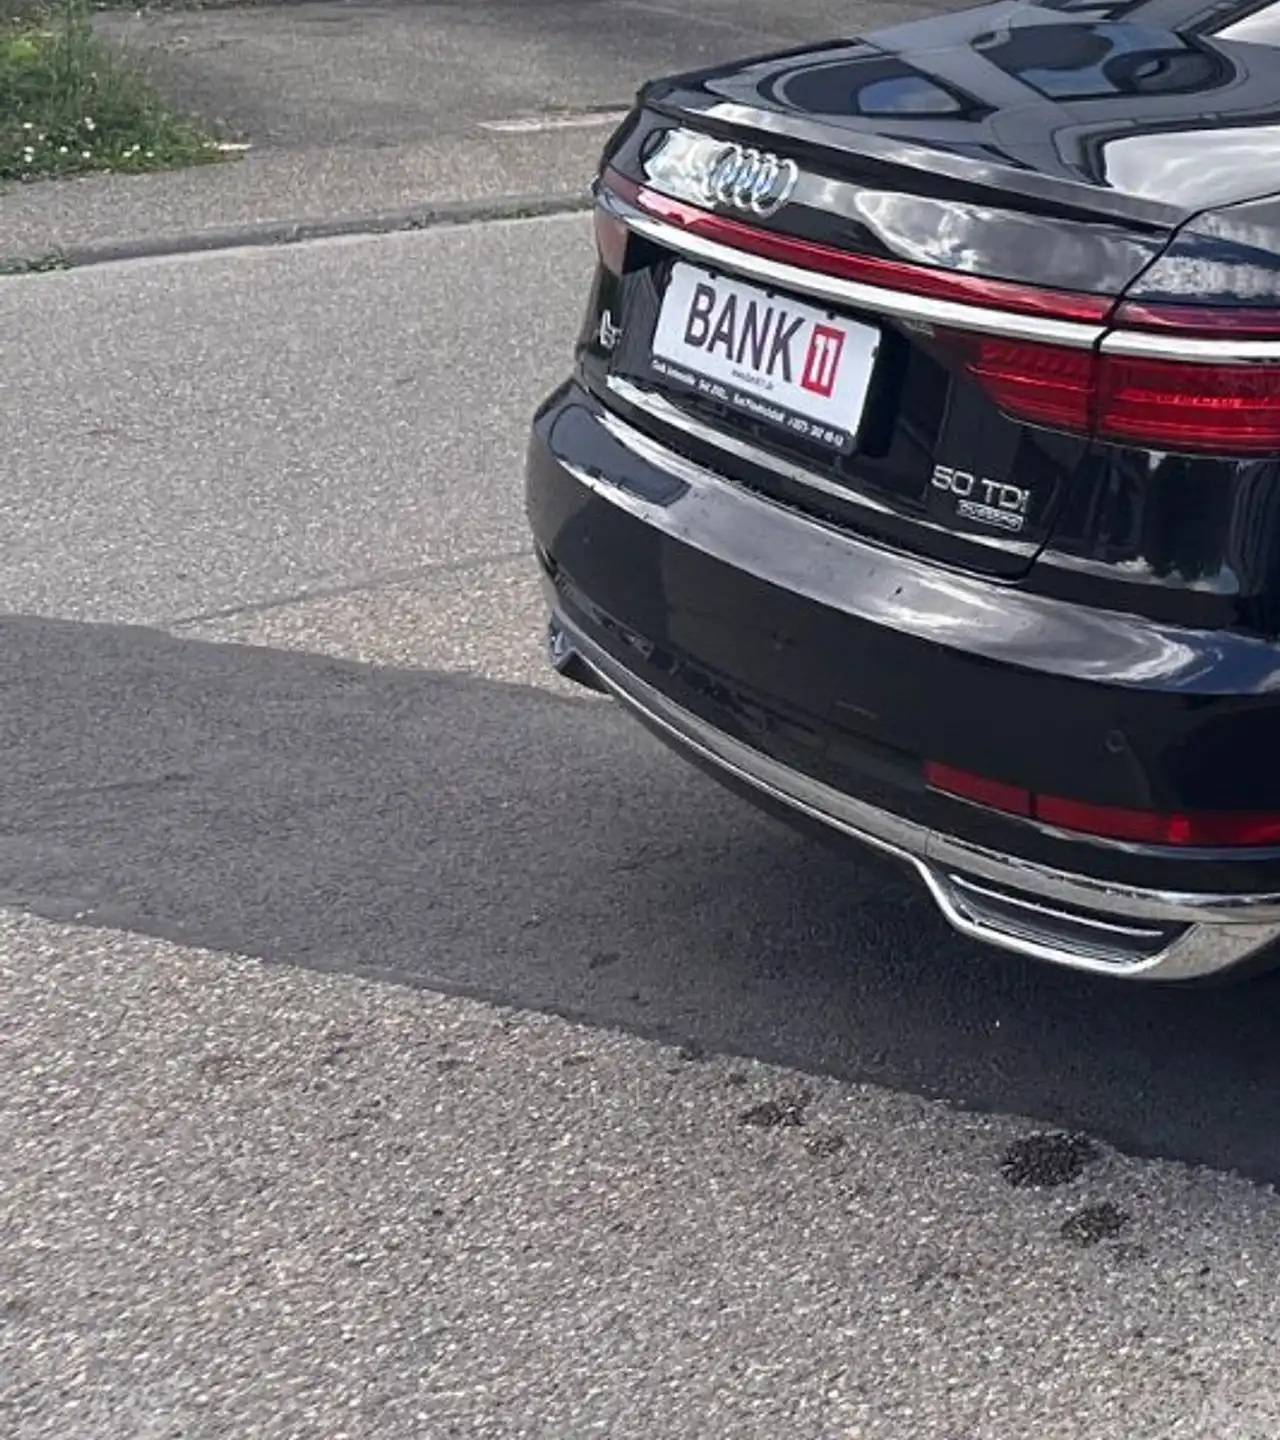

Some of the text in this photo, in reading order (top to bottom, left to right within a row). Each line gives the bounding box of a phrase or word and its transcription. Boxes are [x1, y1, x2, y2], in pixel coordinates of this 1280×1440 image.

[683, 282, 840, 389] BANK 11
[931, 464, 974, 497] 50
